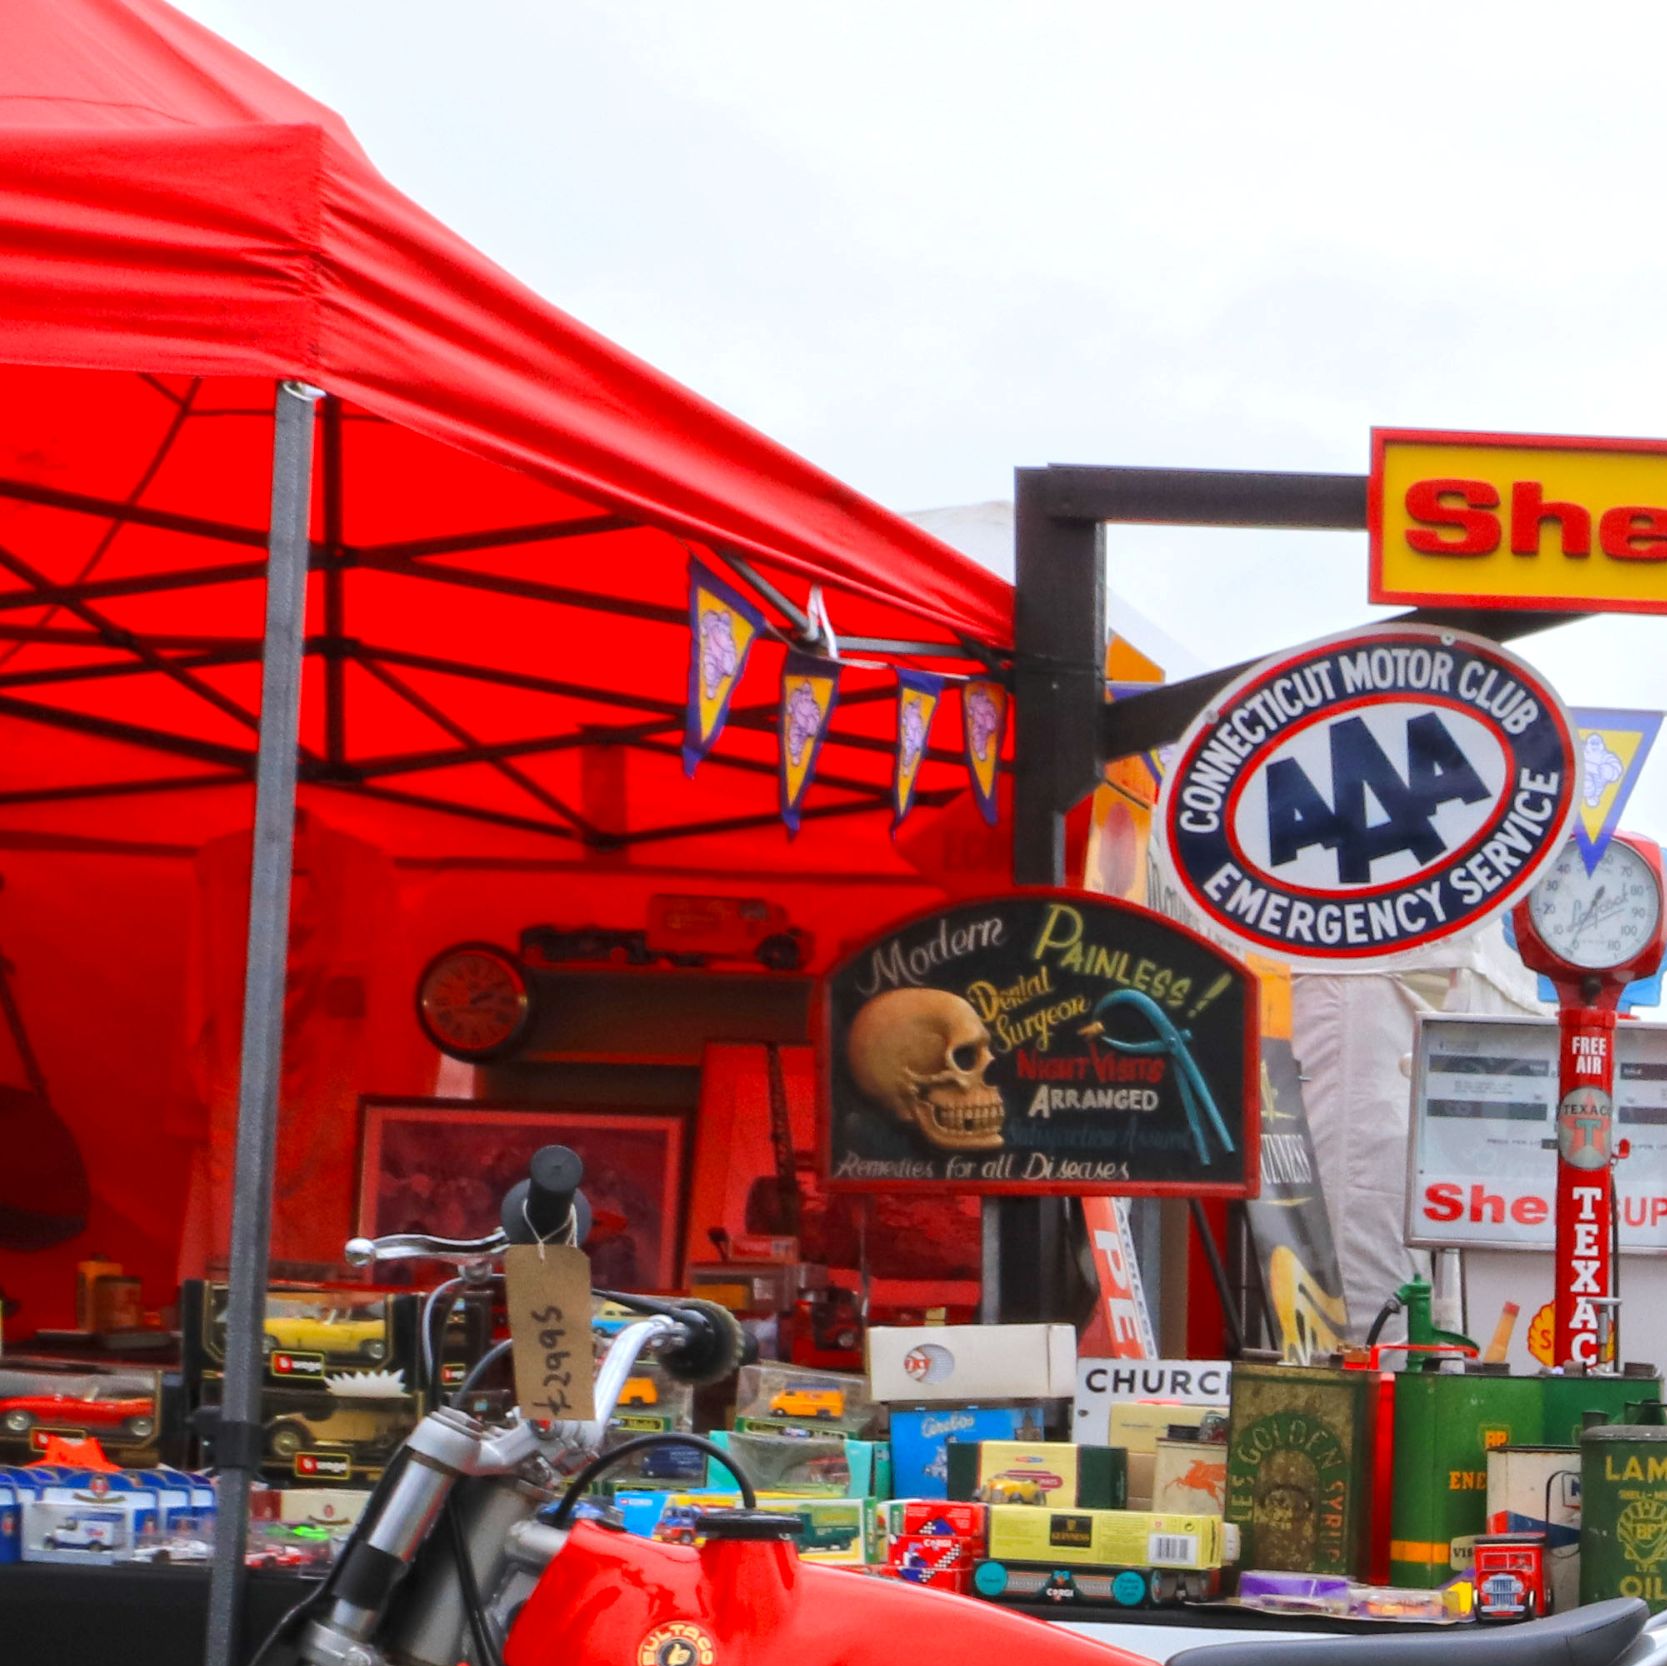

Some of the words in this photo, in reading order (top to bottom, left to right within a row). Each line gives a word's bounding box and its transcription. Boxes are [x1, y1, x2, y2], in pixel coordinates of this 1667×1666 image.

[1180, 661, 1333, 835] CONNECTICUT
[1342, 648, 1454, 694] MOTOR
[1458, 659, 1539, 737] CLUB
[1266, 711, 1492, 885] AAA
[1202, 861, 1448, 946] EMERGENCY
[1450, 767, 1560, 907] SERVICE
[857, 915, 1005, 997] Modern
[967, 967, 1054, 1023] Dental
[995, 994, 1091, 1053] Surgeon
[1571, 1035, 1607, 1056] FREE
[1576, 1055, 1602, 1076] AIR
[1028, 1084, 1159, 1118] ARRANGED
[836, 1150, 934, 1180] Remedies
[981, 1153, 1012, 1179] all
[1021, 1152, 1130, 1181] Diseases
[530, 1306, 573, 1416] £2995
[1238, 1418, 1343, 1470] GOLDEN
[1046, 1587, 1075, 1599] CORGI
